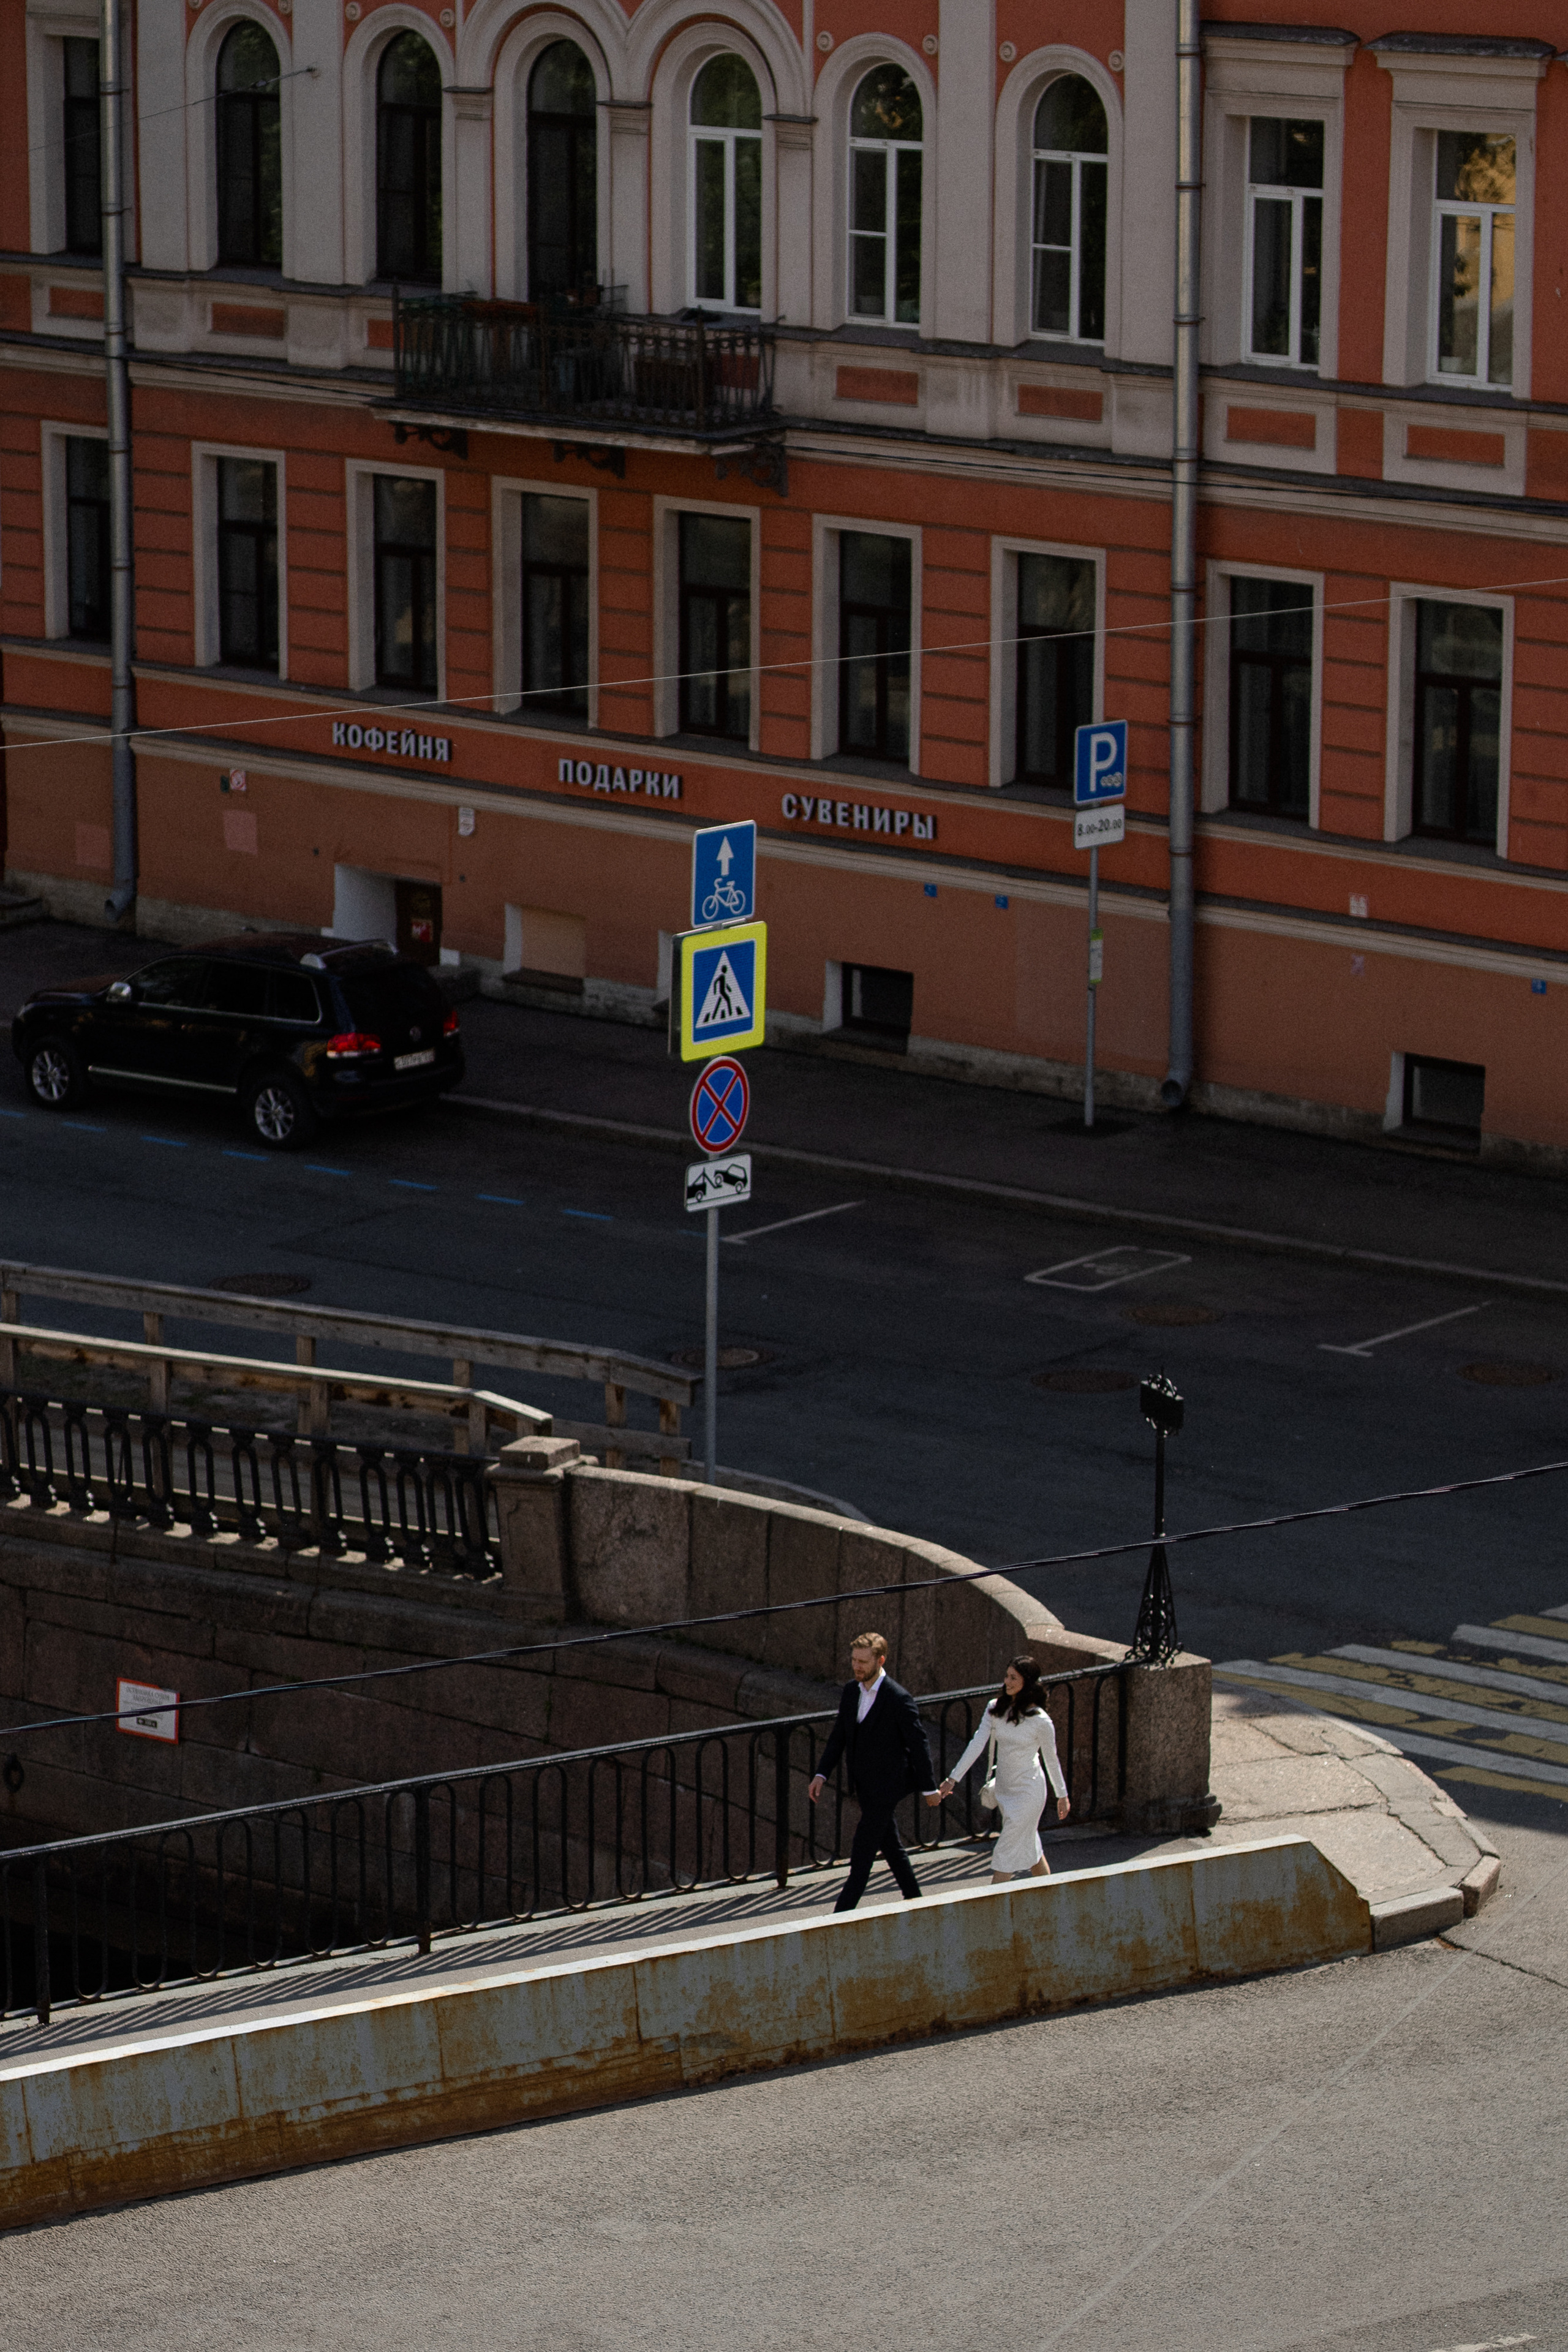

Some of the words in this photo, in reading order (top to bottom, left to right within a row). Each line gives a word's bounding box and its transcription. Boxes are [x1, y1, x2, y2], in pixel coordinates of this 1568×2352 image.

[331, 722, 450, 762] КОФЕЙНЯ
[1089, 731, 1118, 793] P
[558, 758, 680, 799] ПОДАРКИ
[781, 793, 935, 840] СУВЕНИРЫ
